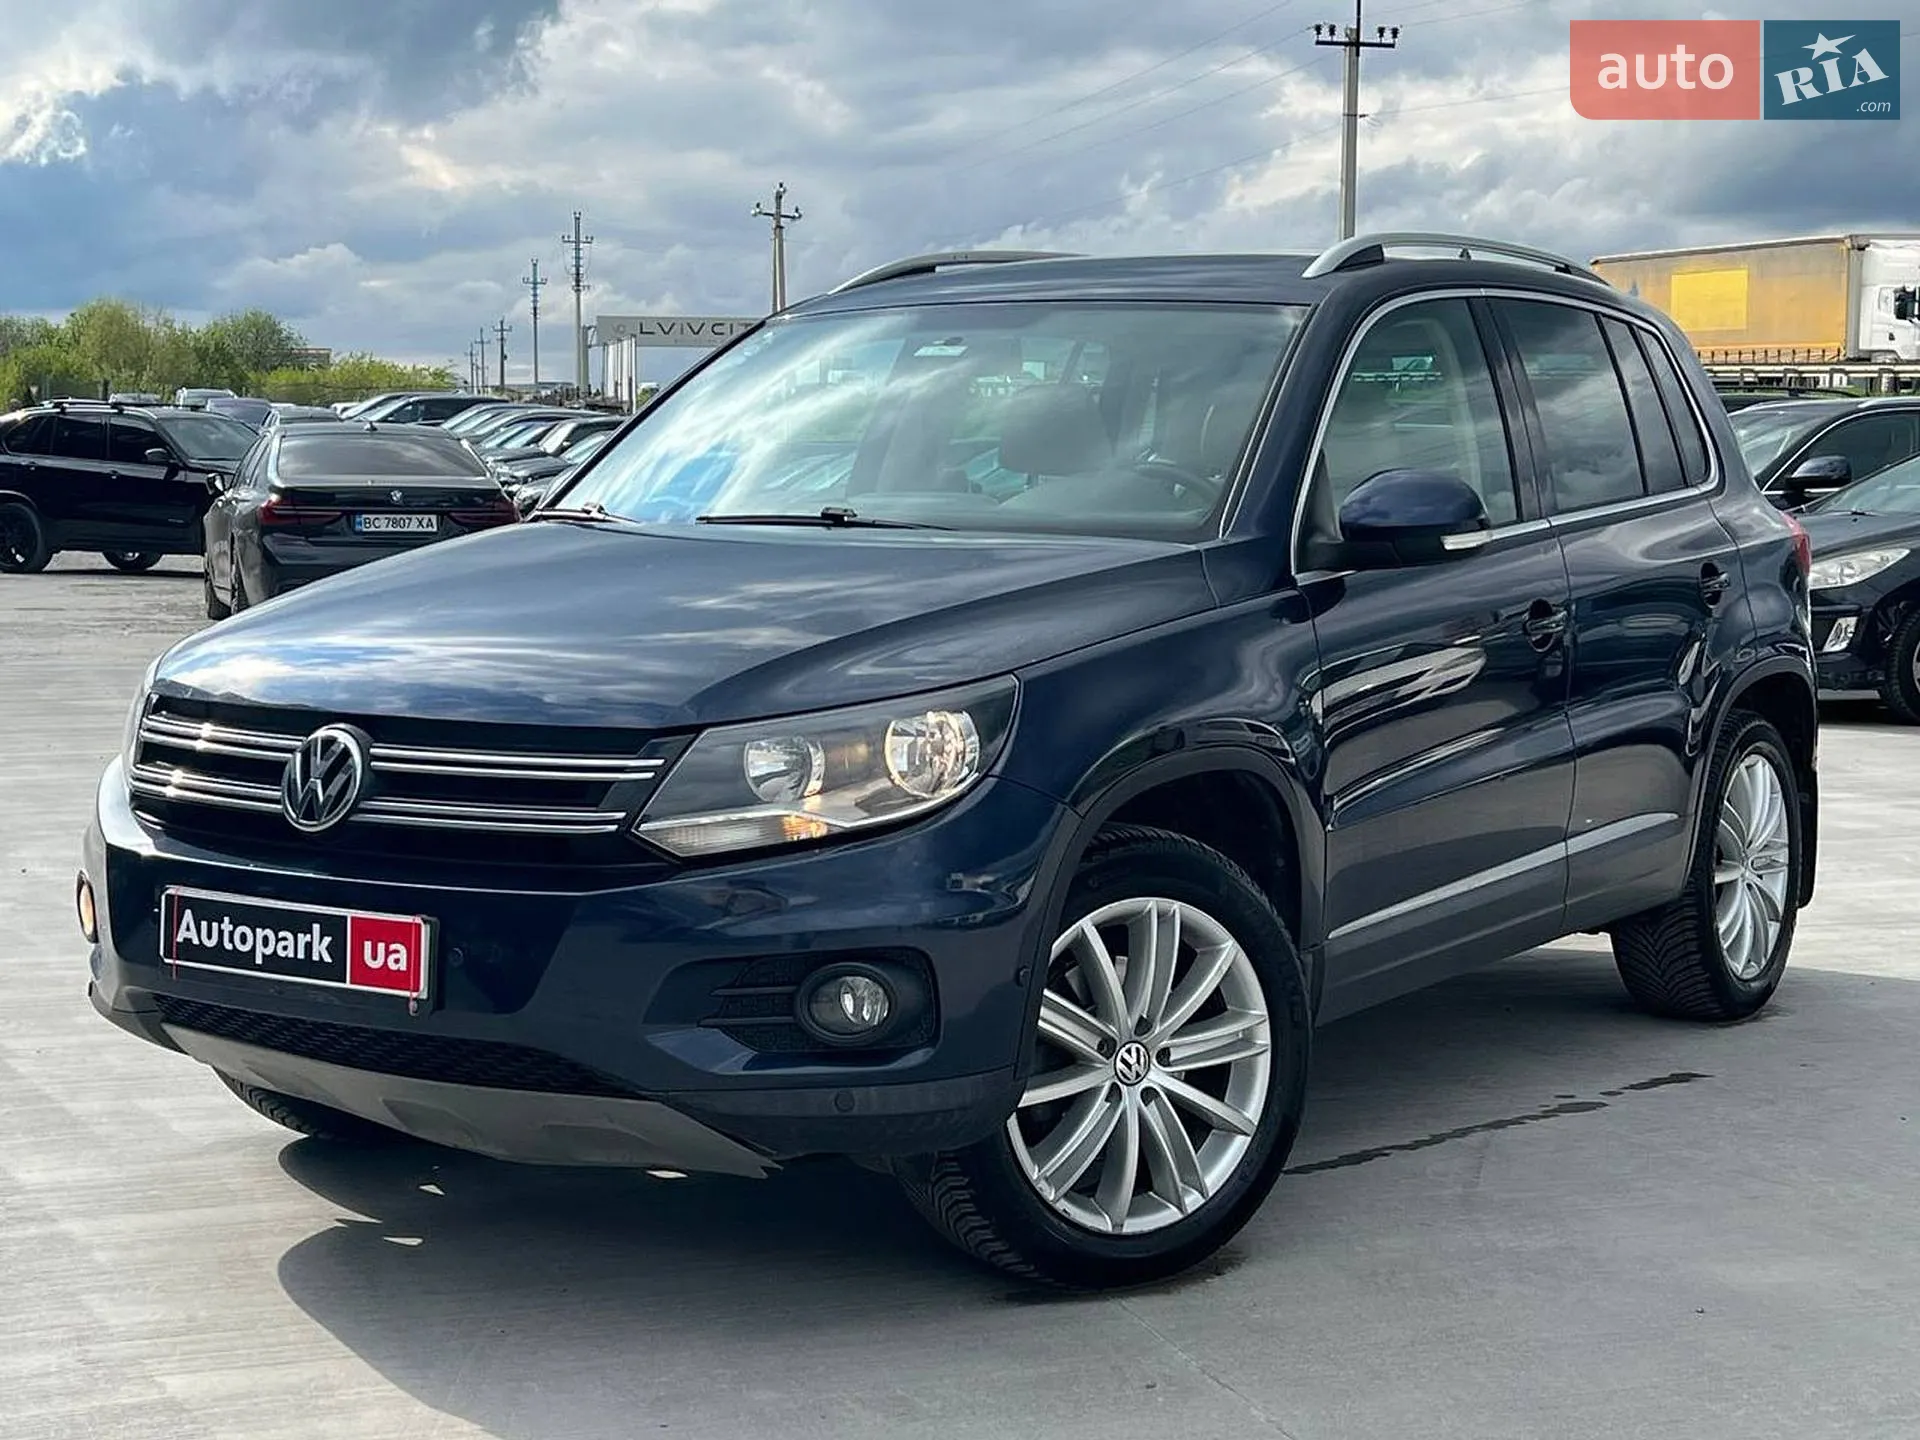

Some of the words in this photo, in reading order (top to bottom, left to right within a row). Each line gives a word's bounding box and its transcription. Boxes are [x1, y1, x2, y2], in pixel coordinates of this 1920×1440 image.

[363, 517, 381, 529] BC
[385, 517, 413, 529] 7807
[416, 517, 435, 529] XA
[176, 908, 333, 965] Autopark
[363, 939, 409, 972] ua
